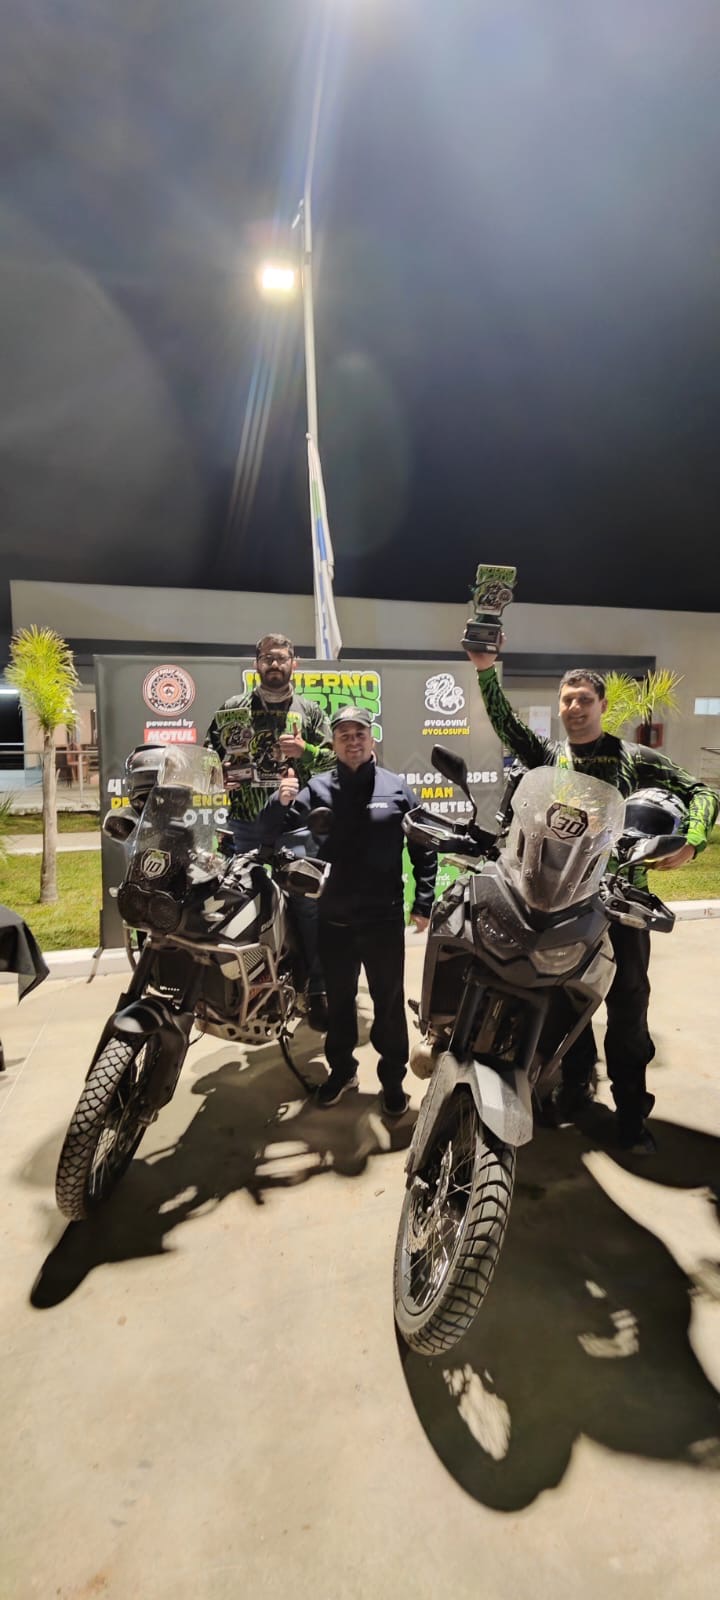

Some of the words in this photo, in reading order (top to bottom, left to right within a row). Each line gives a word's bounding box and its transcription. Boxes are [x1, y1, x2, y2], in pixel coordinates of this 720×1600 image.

[245, 671, 380, 700] IIERNO
[146, 718, 182, 729] powered
[183, 718, 193, 729] by
[147, 730, 193, 741] MOTUL
[421, 787, 453, 799] MAN
[552, 817, 584, 835] 30
[147, 860, 162, 873] 10
